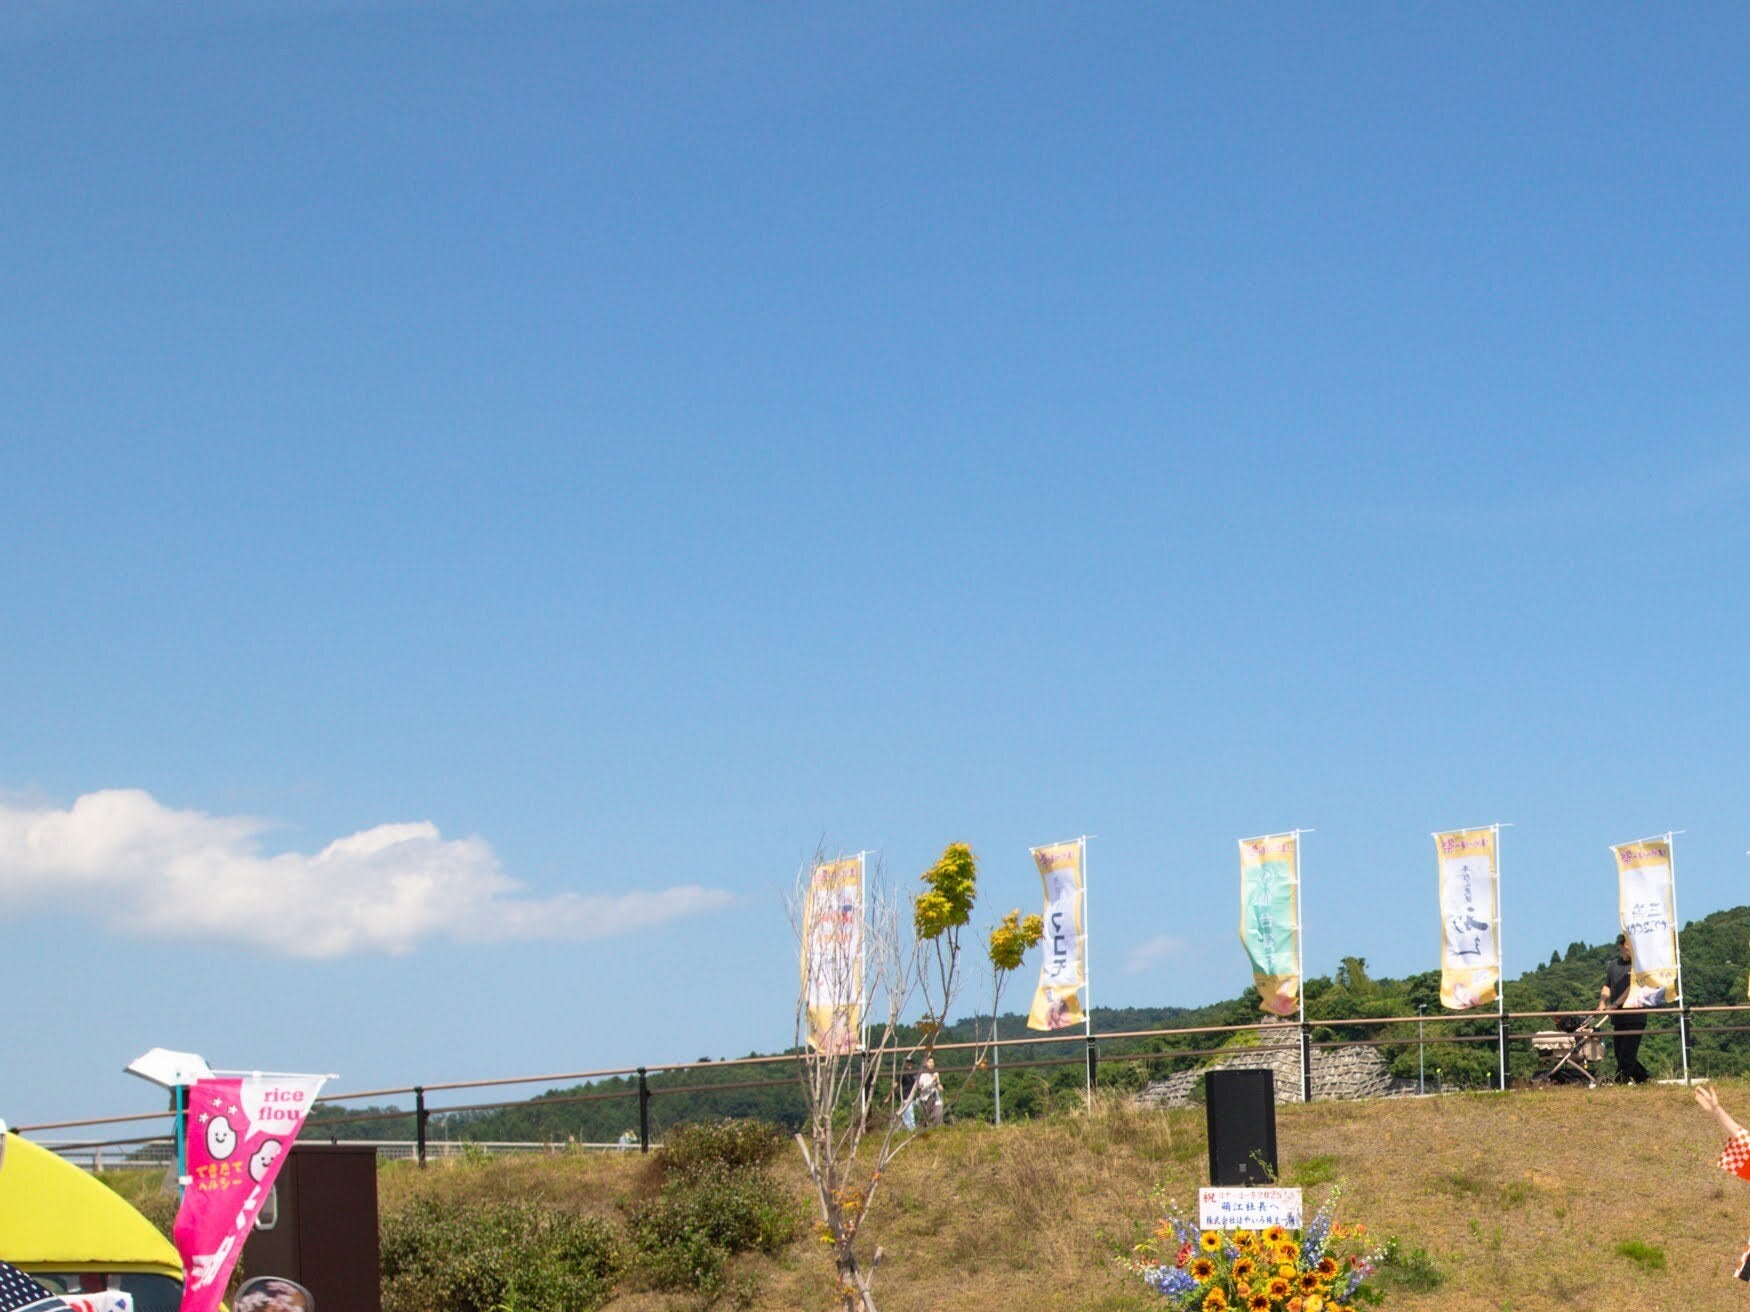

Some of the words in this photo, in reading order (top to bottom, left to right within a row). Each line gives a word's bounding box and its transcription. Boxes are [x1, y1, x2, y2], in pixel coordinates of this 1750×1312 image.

[263, 1088, 305, 1102] rice
[258, 1106, 301, 1121] flou
[195, 1160, 243, 1178] できたて
[198, 1177, 243, 1191] ヘルシー
